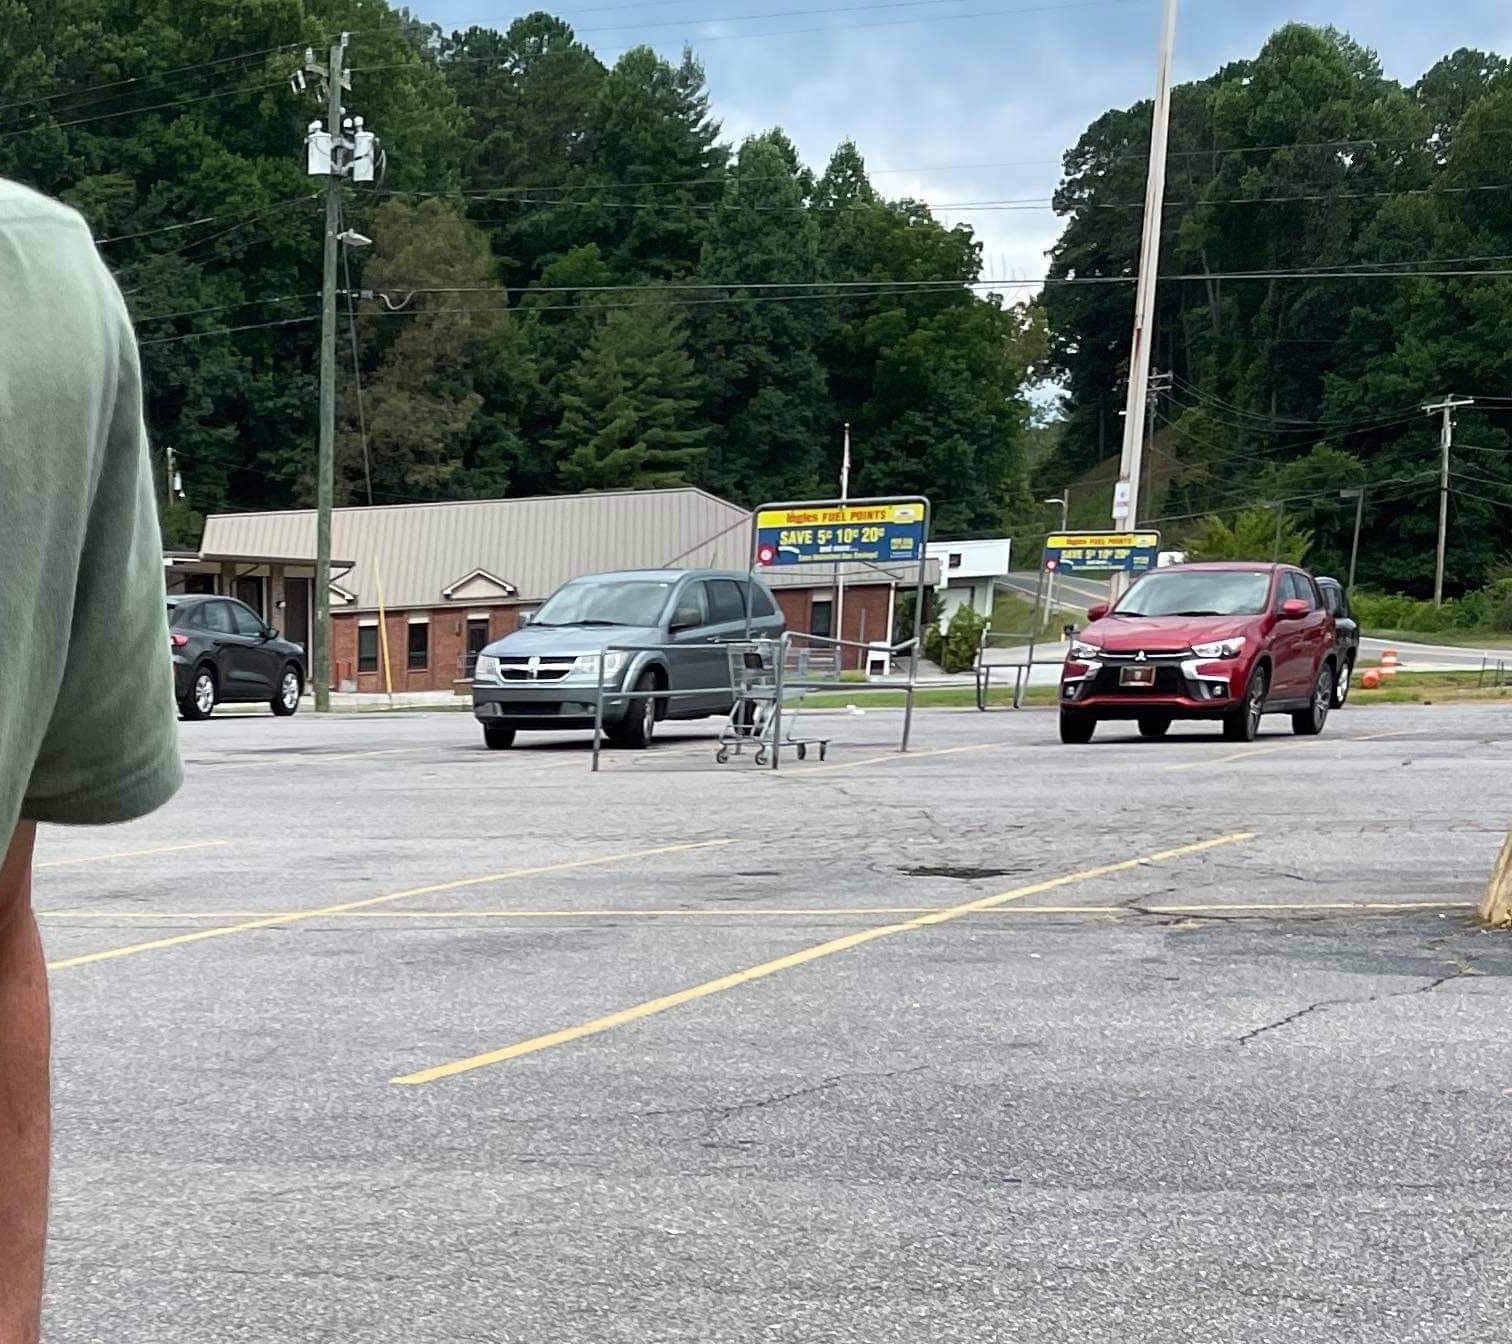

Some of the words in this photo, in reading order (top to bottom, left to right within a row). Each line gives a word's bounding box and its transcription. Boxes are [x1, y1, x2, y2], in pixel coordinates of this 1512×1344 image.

[822, 511, 846, 522] FUEL
[850, 509, 886, 521] POINTS
[780, 529, 813, 545] SAVE
